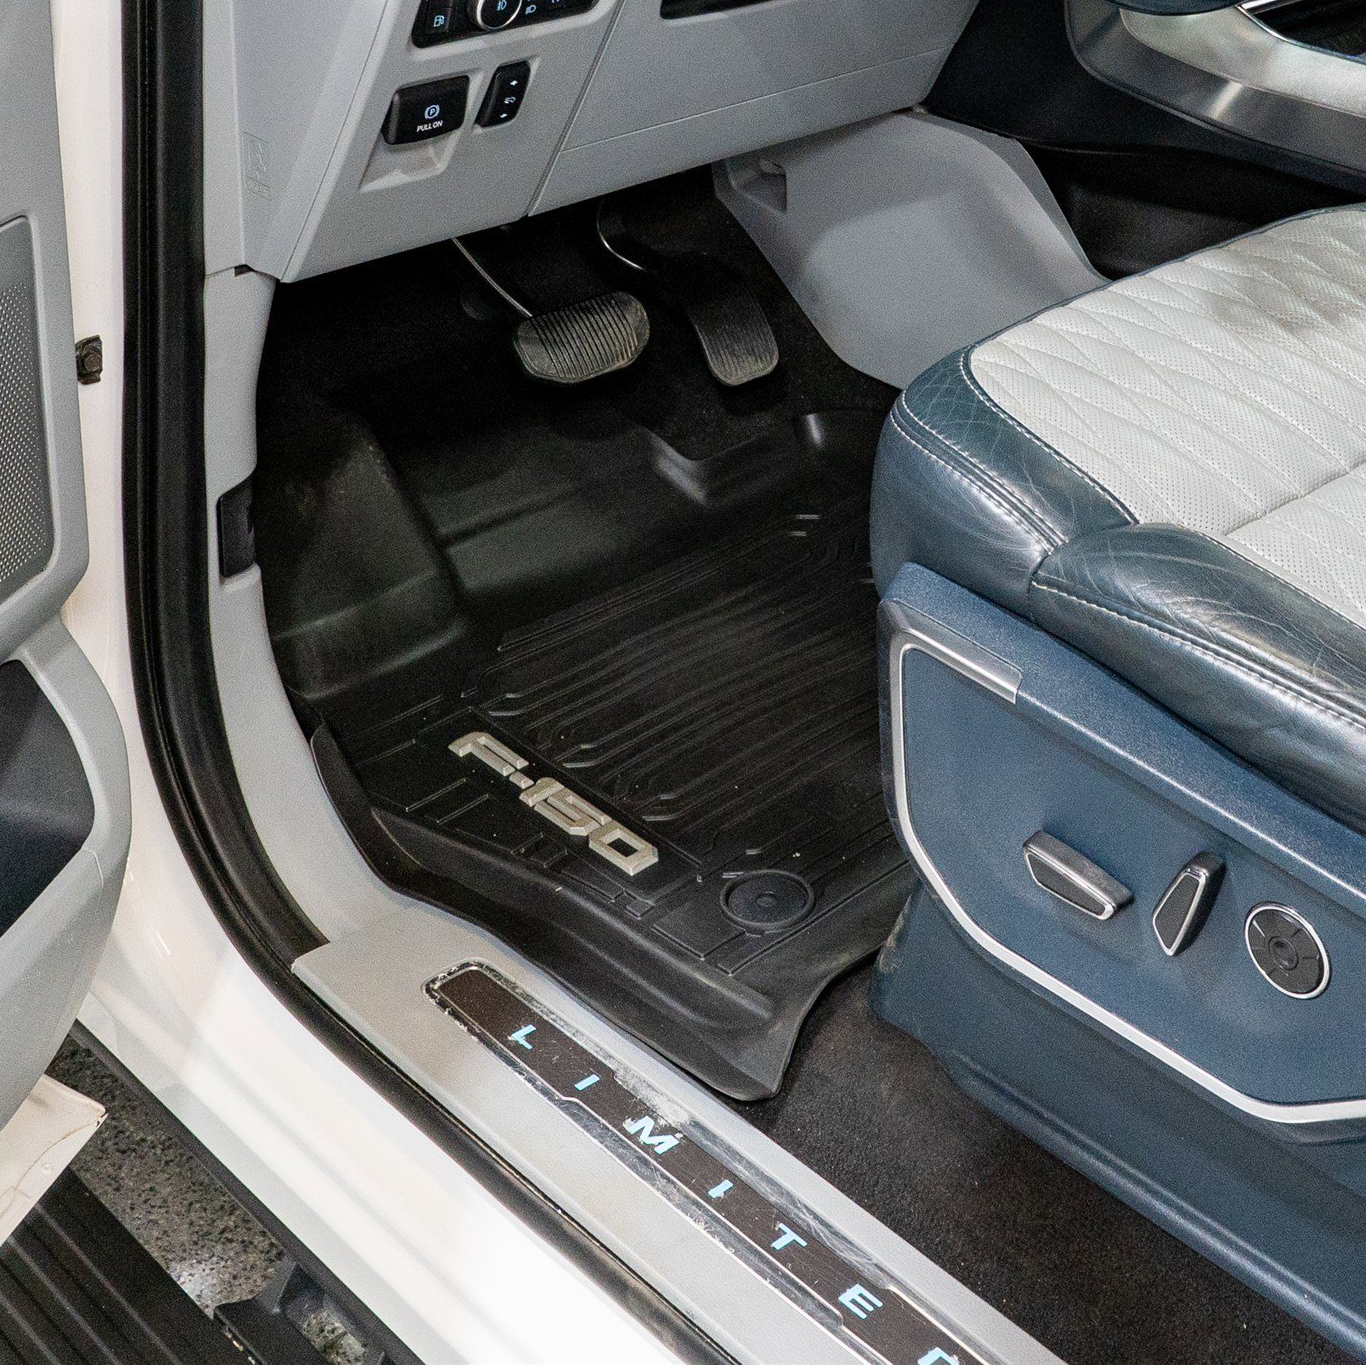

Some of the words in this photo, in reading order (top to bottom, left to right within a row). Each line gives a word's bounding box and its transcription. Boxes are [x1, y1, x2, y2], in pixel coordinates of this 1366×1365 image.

[416, 123, 433, 132] PULL
[432, 120, 443, 128] ON
[448, 731, 659, 877] F-150
